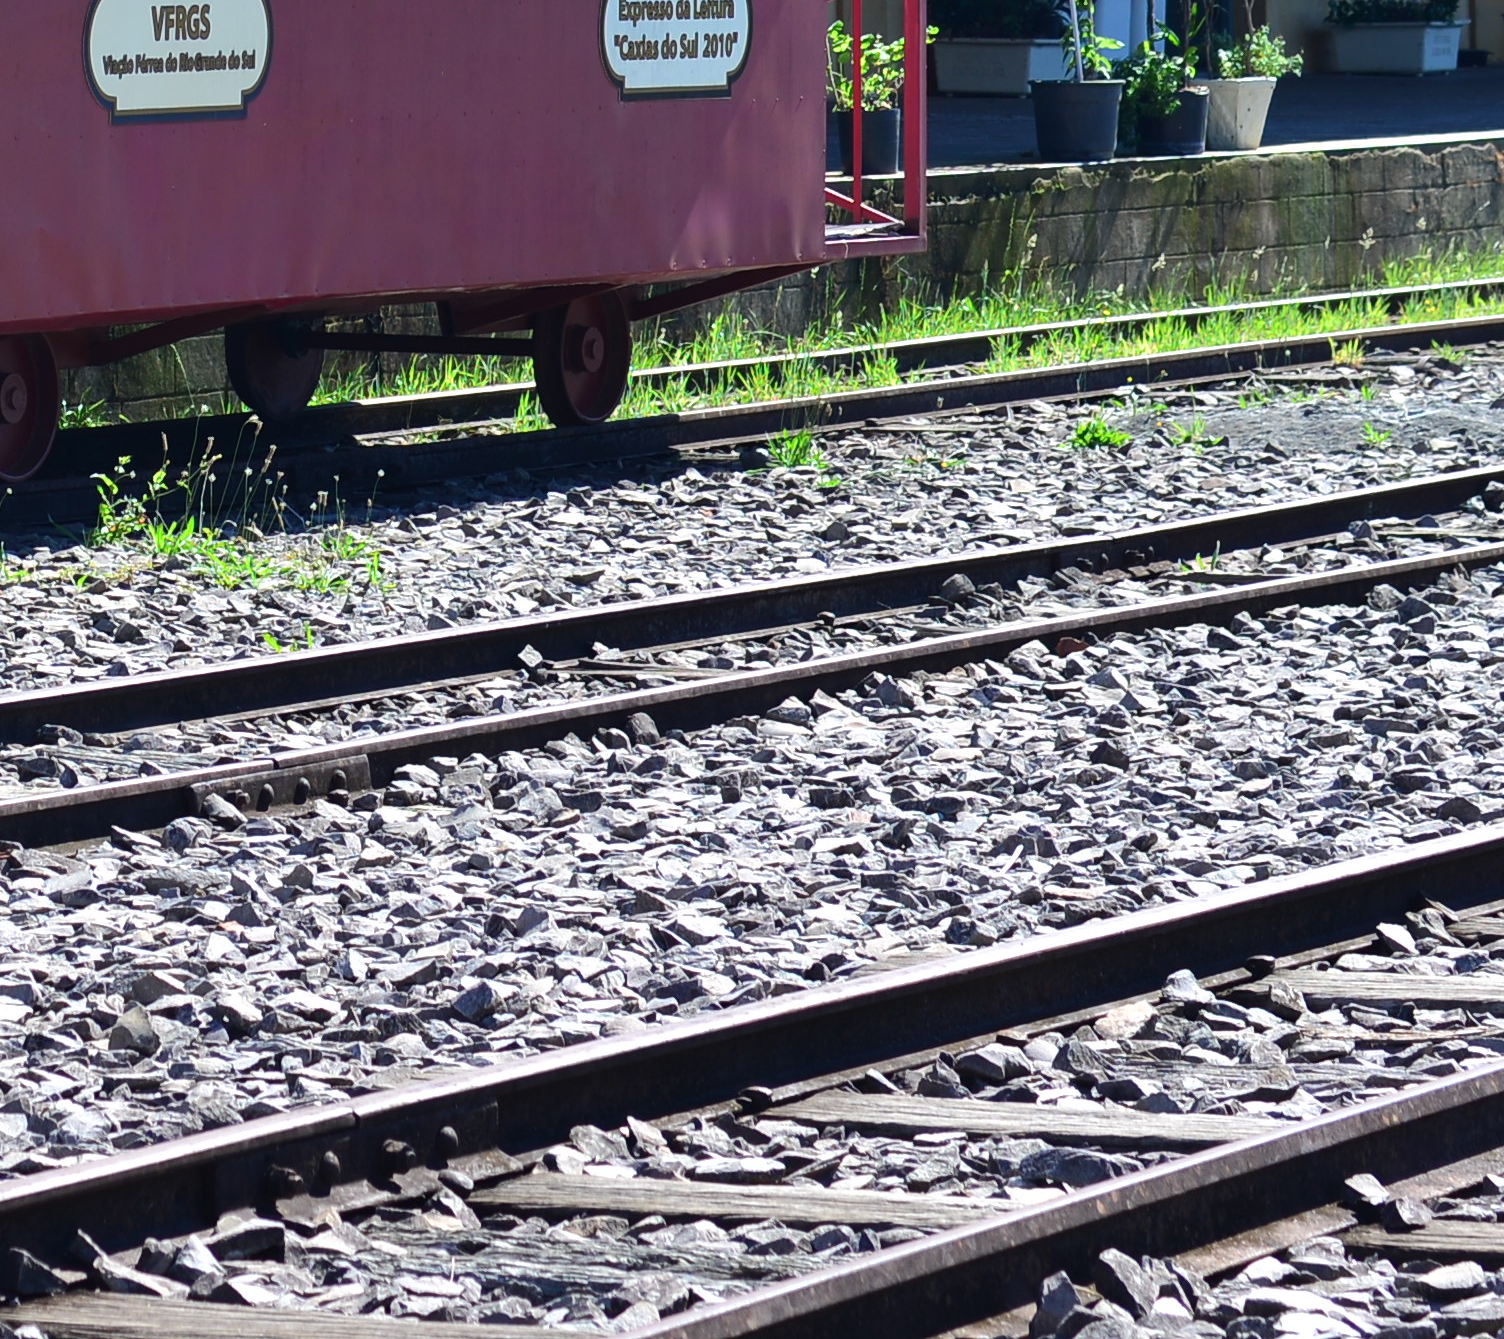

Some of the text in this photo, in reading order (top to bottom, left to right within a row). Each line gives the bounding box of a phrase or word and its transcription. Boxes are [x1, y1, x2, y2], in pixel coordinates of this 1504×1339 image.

[151, 4, 211, 41] VFRGS
[614, 32, 738, 61] "Caxias do Sul 2010"
[103, 49, 256, 80] Viação Férrea do Rio Grande do Sul
